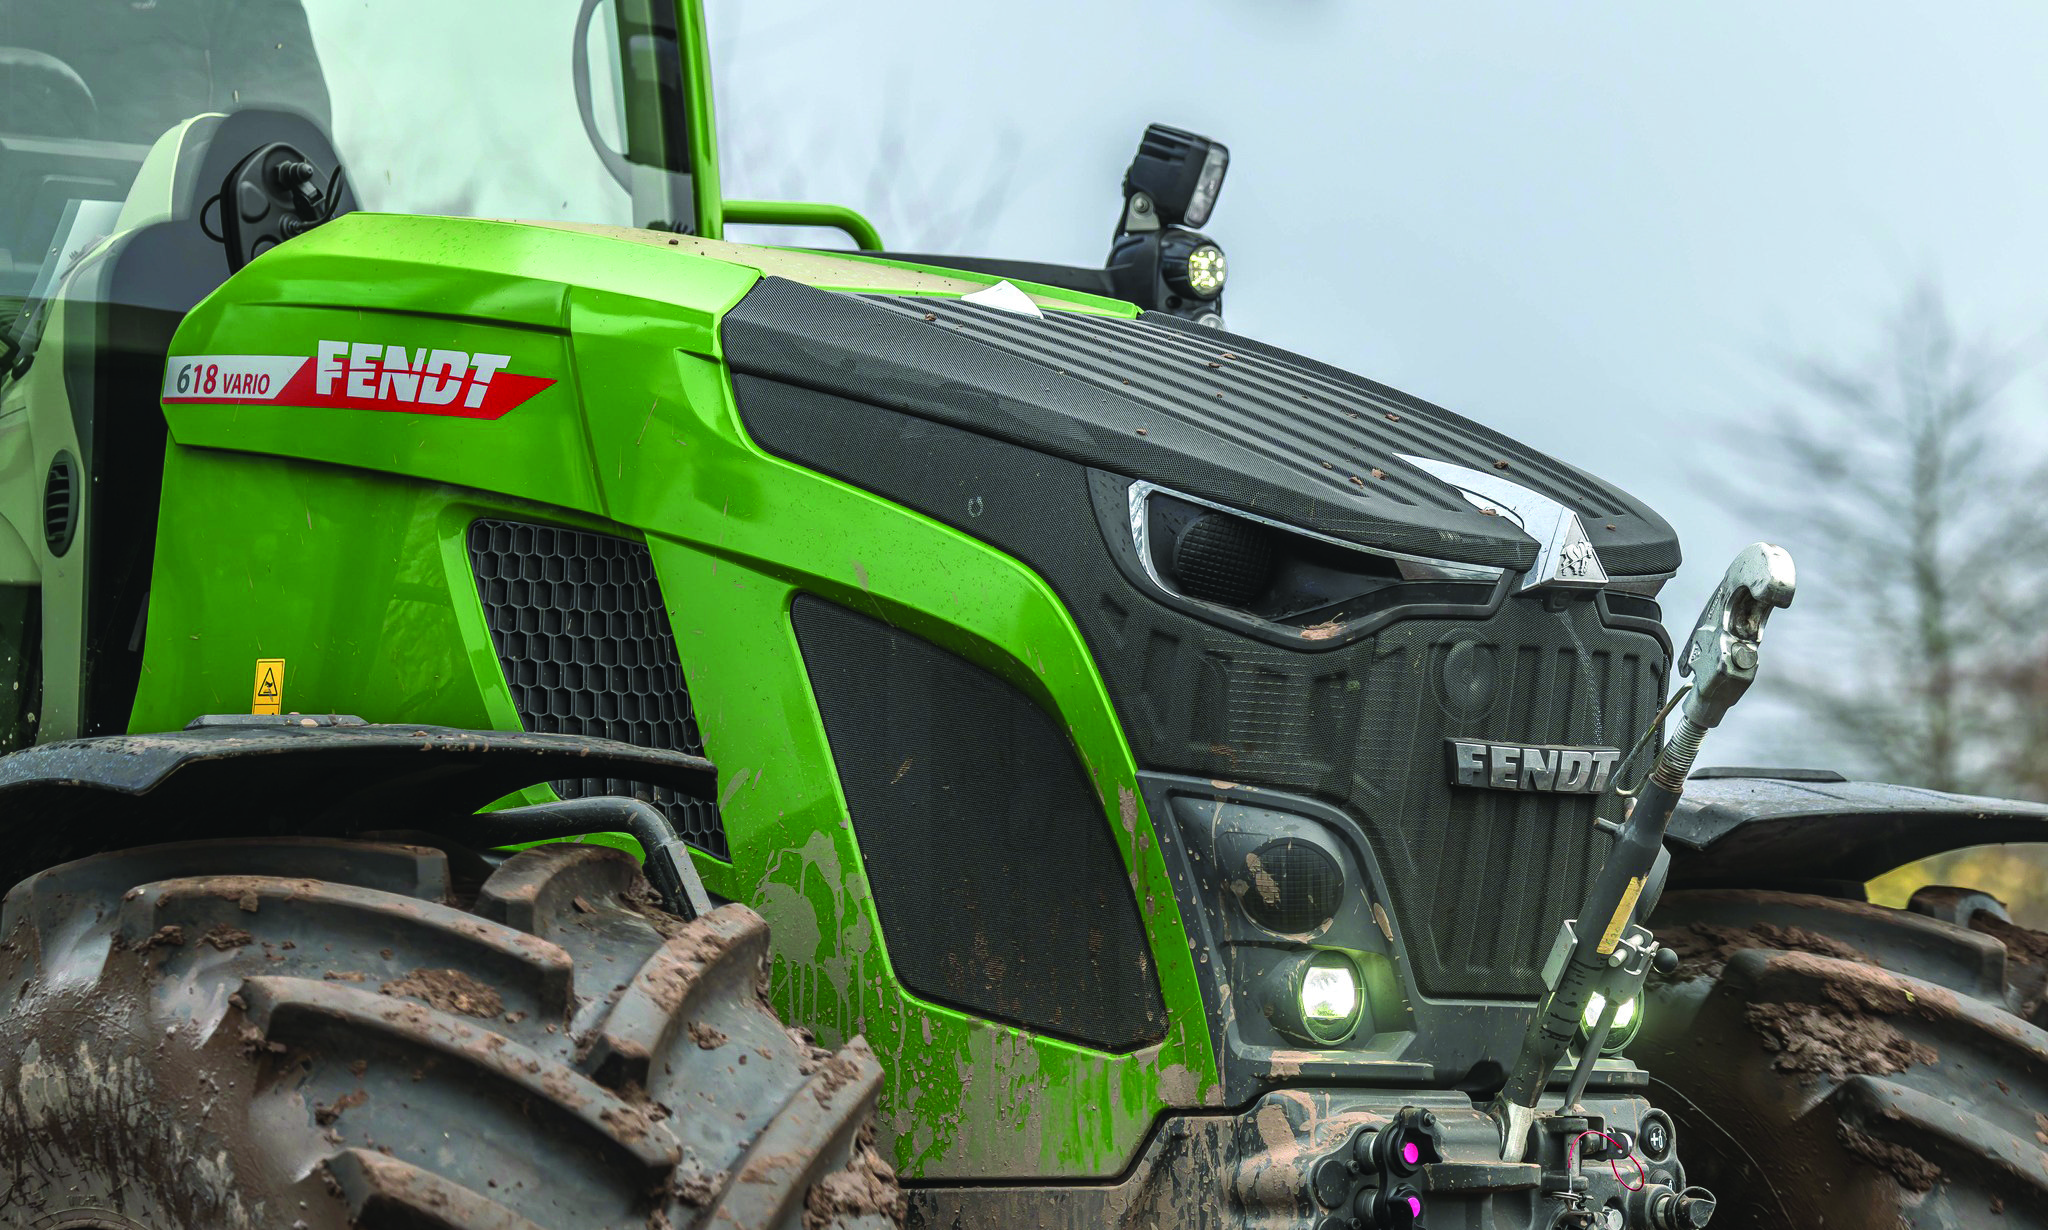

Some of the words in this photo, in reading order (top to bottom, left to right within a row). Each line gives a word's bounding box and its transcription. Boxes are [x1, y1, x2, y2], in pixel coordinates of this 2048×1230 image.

[177, 363, 218, 395] 618
[223, 373, 270, 395] VARIO
[316, 339, 511, 408] FENDT
[1455, 742, 1620, 792] FENDT
